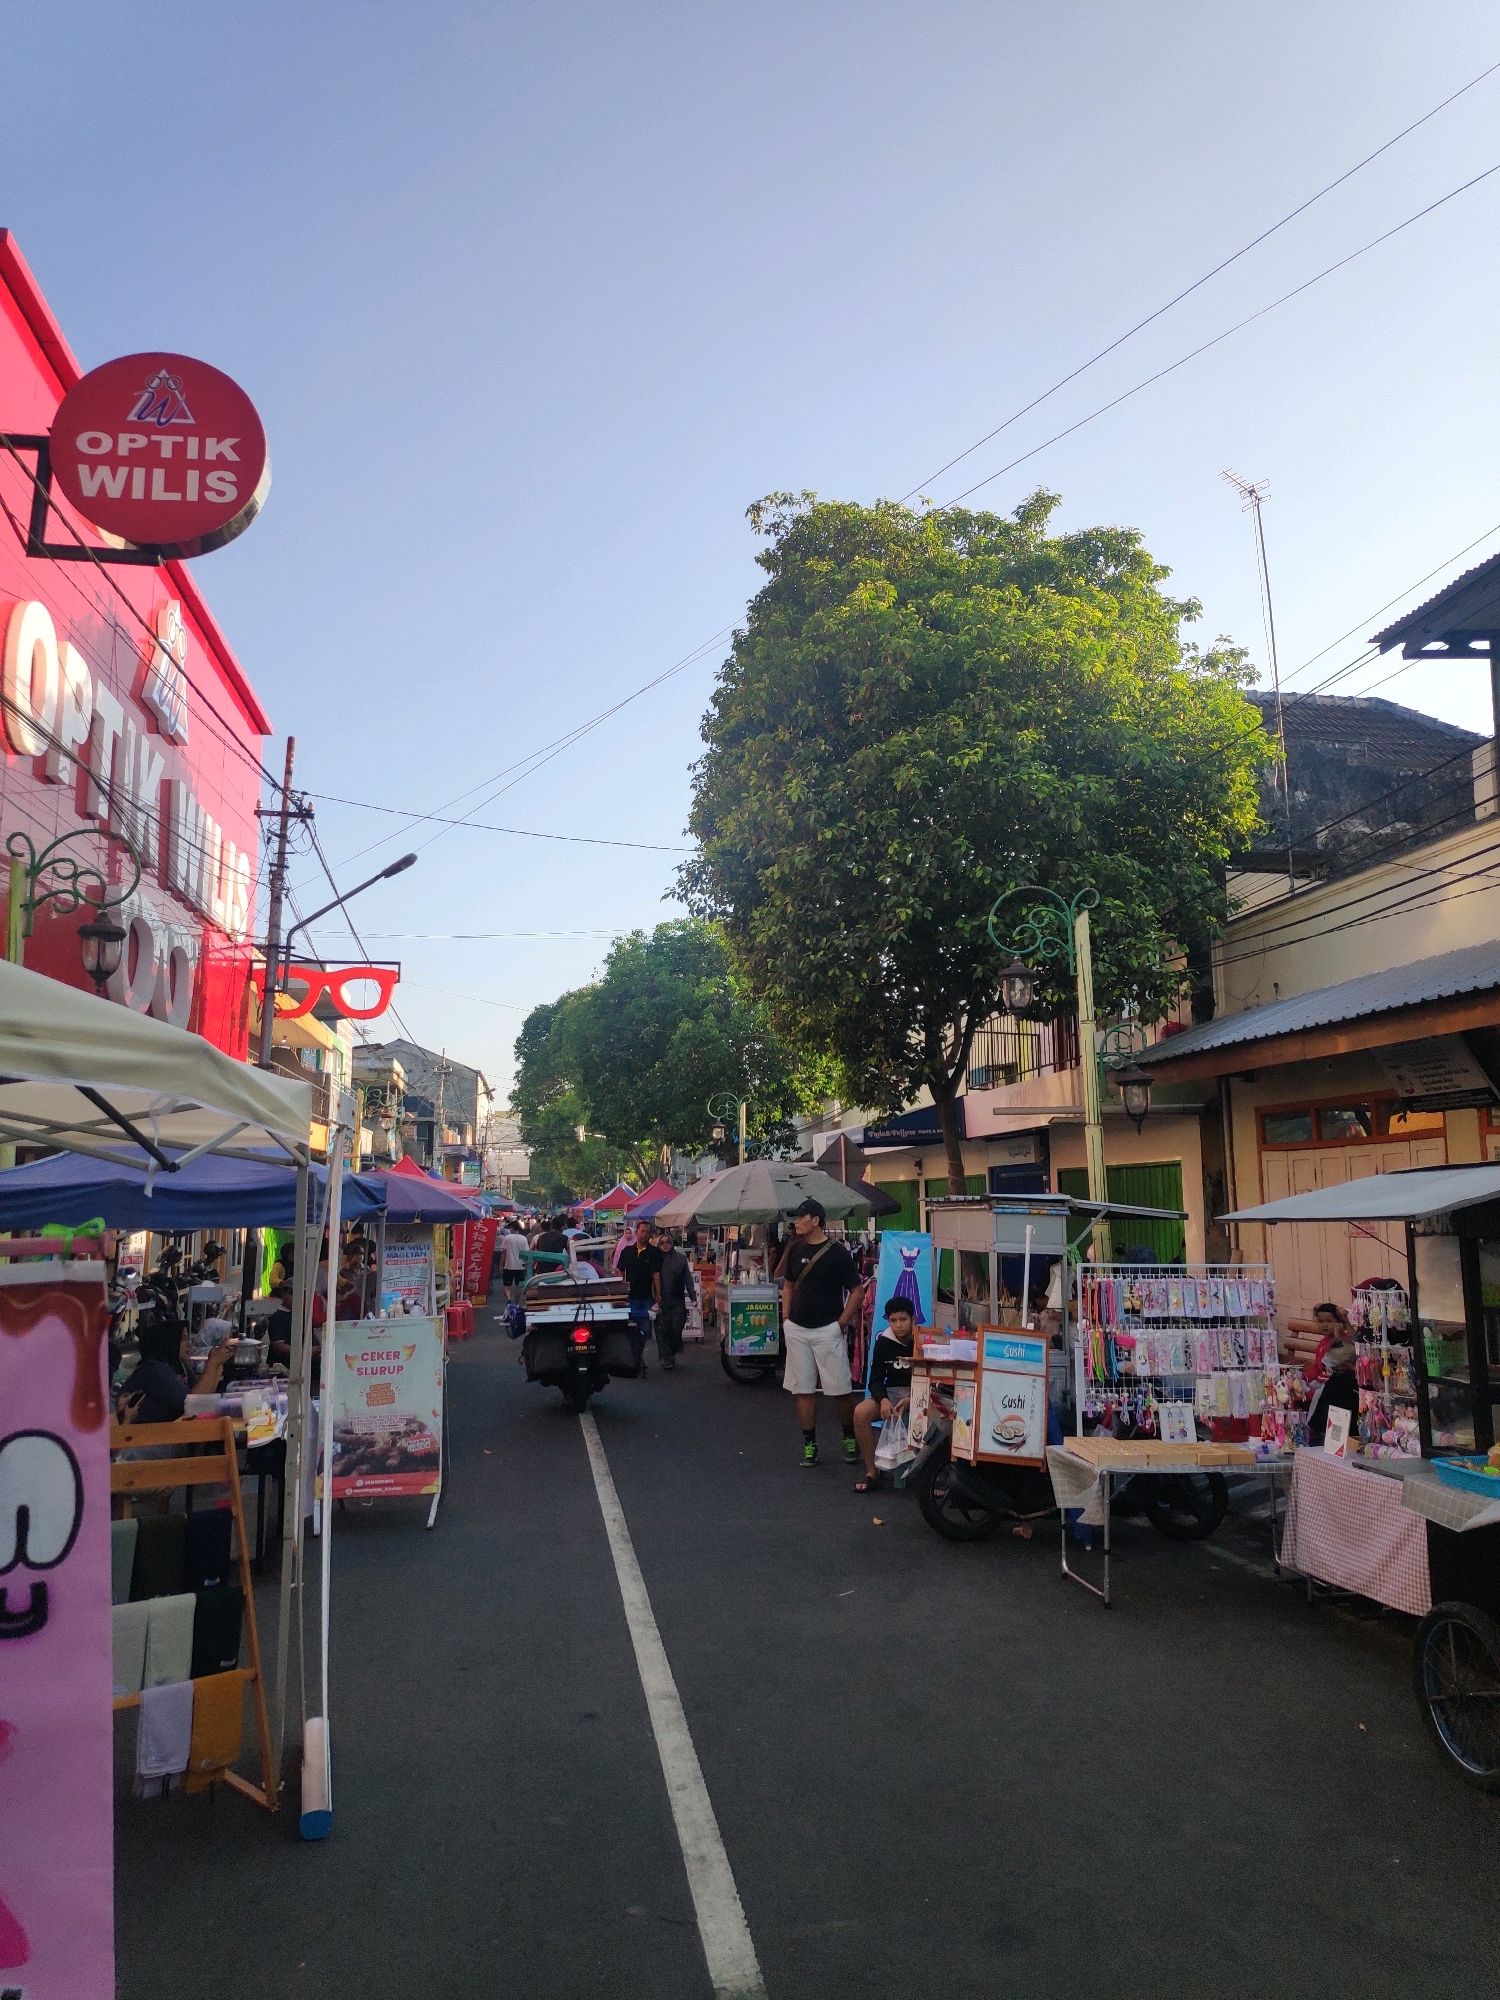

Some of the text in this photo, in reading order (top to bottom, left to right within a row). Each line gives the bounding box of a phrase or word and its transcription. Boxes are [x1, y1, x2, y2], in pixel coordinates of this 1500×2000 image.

[75, 431, 242, 462] OPTIK
[77, 464, 238, 503] WILIS
[2, 600, 250, 942] OPTIK WILIS
[467, 1220, 488, 1293] おねえさん寿司
[745, 1303, 774, 1311] JASUKE
[361, 1351, 401, 1362] CEKER
[1003, 1344, 1026, 1358] Sushi
[356, 1365, 404, 1376] SLURUP
[1001, 1393, 1026, 1410] Sushi
